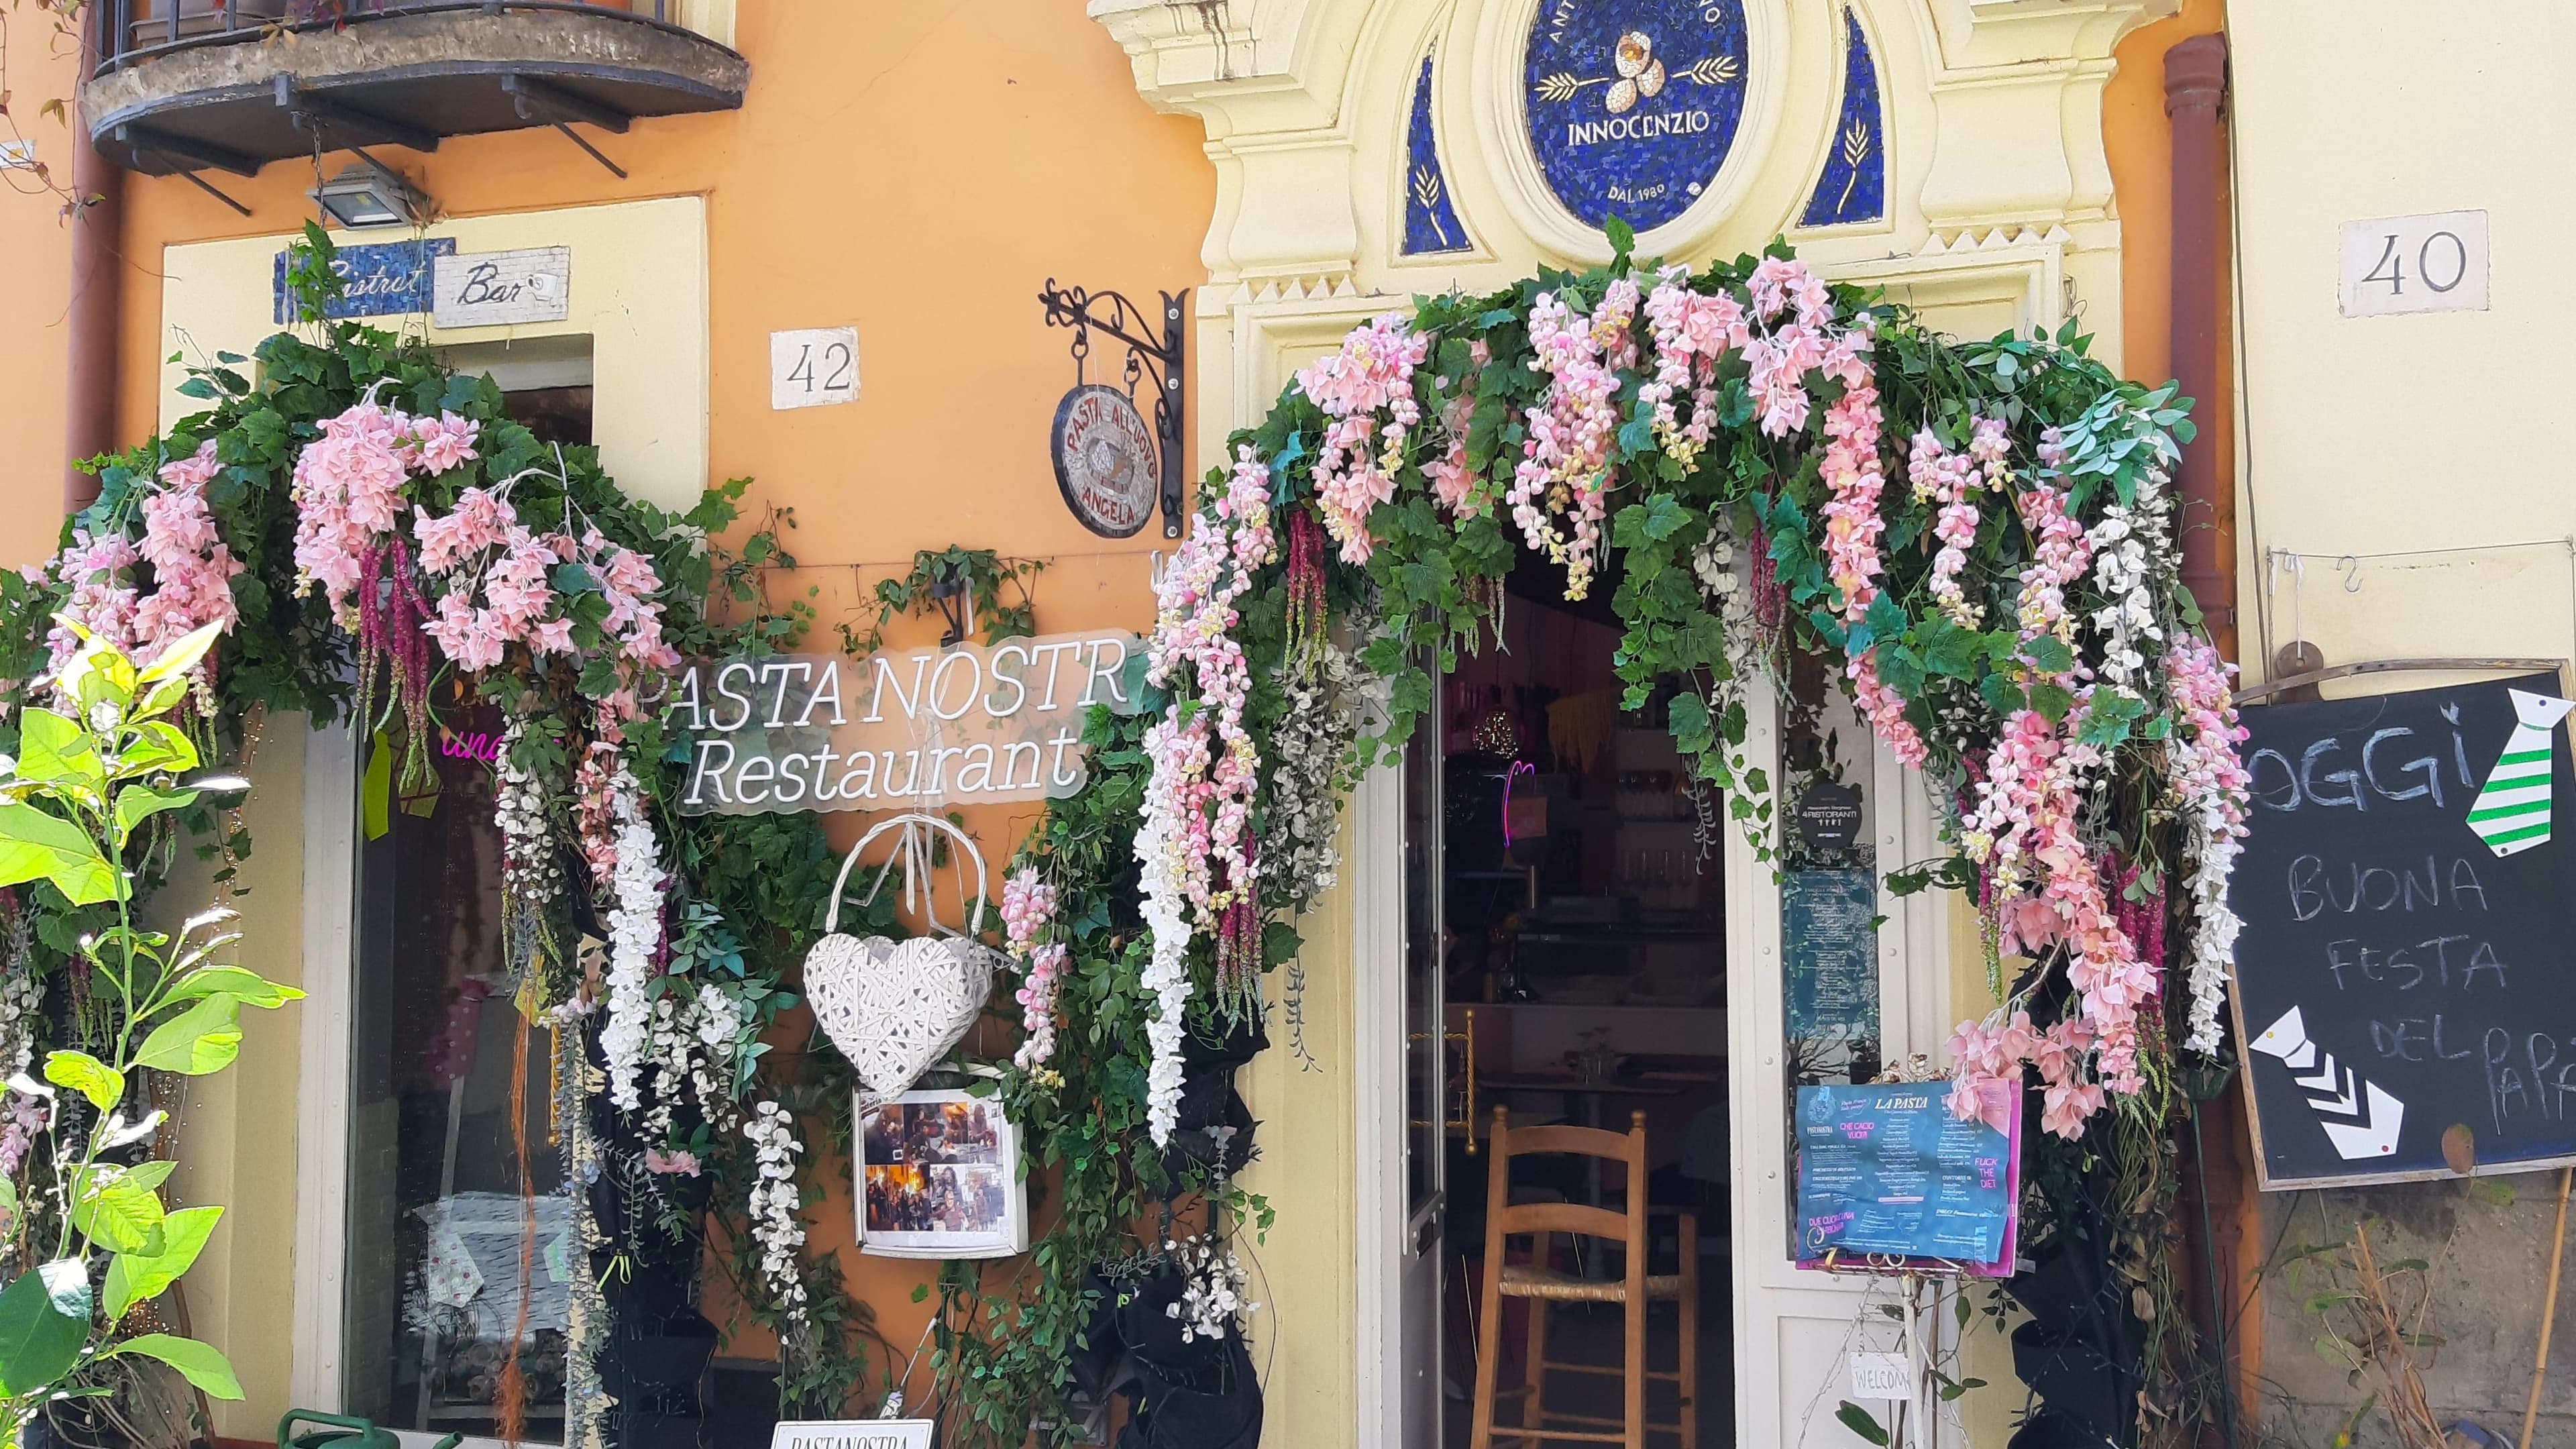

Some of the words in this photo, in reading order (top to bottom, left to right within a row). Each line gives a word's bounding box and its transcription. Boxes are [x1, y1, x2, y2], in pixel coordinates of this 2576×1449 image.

[1568, 110, 1710, 146] INNOCENZIO
[1607, 185, 1635, 203] DAL
[1638, 184, 1665, 201] 1980
[457, 262, 525, 305] Bar
[2361, 231, 2467, 296] 40
[786, 342, 851, 392] 42
[1067, 396, 1103, 452] PASTA
[1081, 487, 1134, 525] ANGELA
[861, 637, 1128, 723] NOSTR
[683, 727, 1077, 806] Restaurant
[2289, 855, 2488, 921] BUONA
[2326, 934, 2510, 990] FESTA
[2370, 1014, 2472, 1061] DEL
[1874, 1098, 1892, 1109] LA
[1893, 1097, 1928, 1109] PASTA
[1975, 1157, 1998, 1166] FUCK
[1979, 1168, 1994, 1177] THE
[1980, 1179, 1996, 1189] DIET
